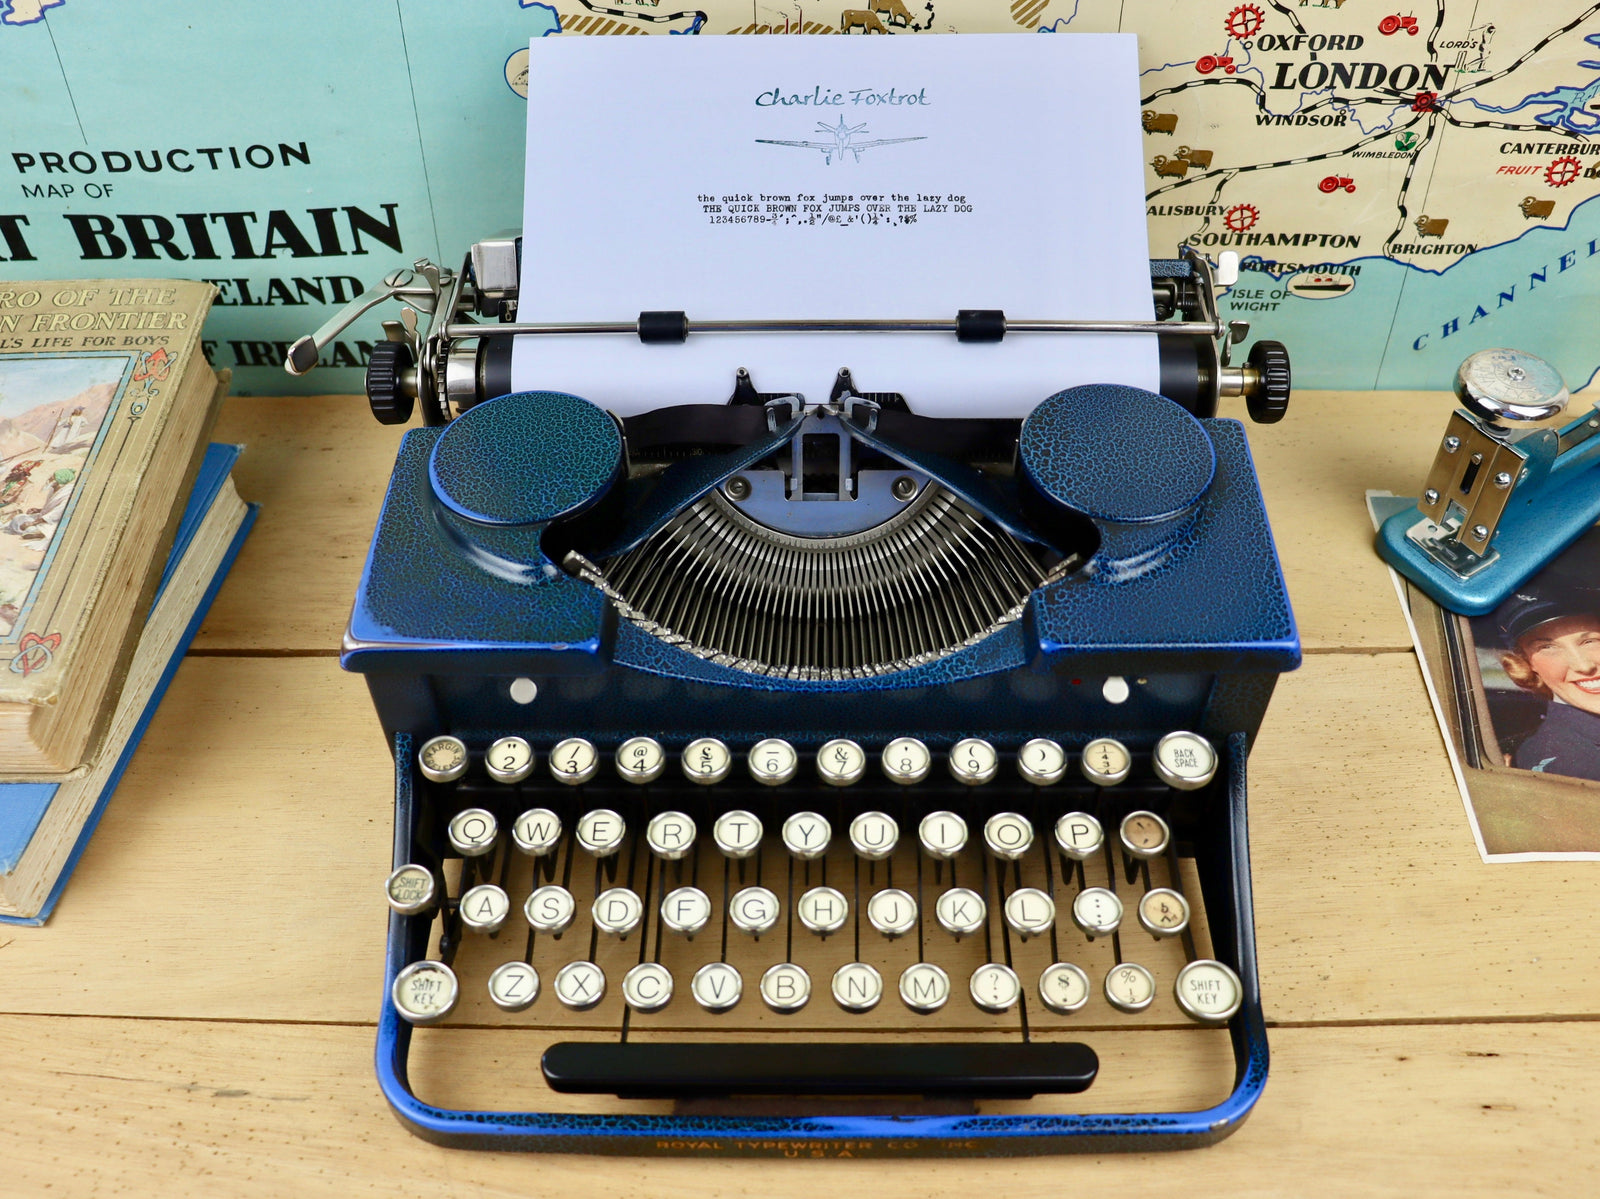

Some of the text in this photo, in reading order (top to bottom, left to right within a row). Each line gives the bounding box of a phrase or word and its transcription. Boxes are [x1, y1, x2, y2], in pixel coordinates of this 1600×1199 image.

[1256, 34, 1364, 51] OXFORD
[1439, 38, 1478, 49] LORD'S
[1269, 61, 1456, 91] LONDON
[755, 85, 931, 106] Charlie Foxtrot
[1255, 114, 1347, 127] WINDSOR
[11, 141, 311, 174] PRODUCTION
[1351, 151, 1415, 159] WIMBLEDON
[1496, 165, 1542, 175] FRUIT
[21, 183, 114, 198] MAP OF
[697, 194, 715, 202] the
[722, 194, 753, 204] quick
[760, 194, 791, 202] brown
[797, 194, 815, 202] fox
[822, 194, 854, 204] jumps
[891, 194, 909, 202] the
[917, 194, 941, 204] lazy
[947, 194, 966, 204] dog
[703, 204, 973, 214] THE QUICK BROWN FOX JUMPS OVER THE LAZY DOG
[1146, 206, 1229, 216] ALISBURY
[63, 204, 403, 260] BRITAIN
[1188, 233, 1361, 249] SOUTHAMPTON
[1391, 243, 1478, 255] BRIGHTON
[1240, 262, 1361, 276] PORTSMOUTH
[52, 287, 100, 308] OF
[109, 287, 177, 306] THE
[1232, 289, 1293, 299] ISLE OF
[1230, 302, 1281, 311] WIGHT
[29, 311, 188, 332] FRONTIER
[32, 336, 73, 348] LIFE
[82, 335, 117, 347] FOR
[122, 335, 170, 346] BOYS
[503, 756, 515, 769] 2
[1173, 749, 1195, 759] BACK
[1174, 758, 1199, 768] SPACE
[632, 759, 646, 773] 4
[767, 759, 778, 772] 6
[463, 818, 487, 843] Q
[527, 823, 550, 841] W
[593, 822, 610, 841] E
[663, 824, 681, 844] R
[730, 823, 748, 843] T
[799, 824, 815, 845] Y
[864, 824, 884, 845] U
[940, 823, 945, 845] I
[997, 824, 1021, 845] O
[1071, 824, 1089, 845] P
[400, 877, 427, 889] SHIFT
[477, 896, 493, 916] A
[542, 898, 559, 920] S
[608, 900, 628, 922] D
[678, 900, 695, 921] F
[743, 899, 766, 920] G
[815, 900, 832, 920] H
[885, 902, 898, 924] J
[953, 901, 971, 923] K
[1021, 900, 1041, 922] L
[411, 979, 442, 991] SHIFT
[504, 975, 524, 997] Z
[572, 974, 590, 997] X
[637, 976, 660, 999] C
[710, 976, 725, 999] V
[777, 976, 795, 999] B
[849, 976, 866, 998] N
[914, 977, 936, 999] M
[1190, 980, 1221, 991] SHIFT
[413, 993, 435, 1004] KEY
[1197, 993, 1218, 1005] KEY
[656, 1141, 723, 1149] ROYAL
[736, 1141, 873, 1149] TYPEWRITER
